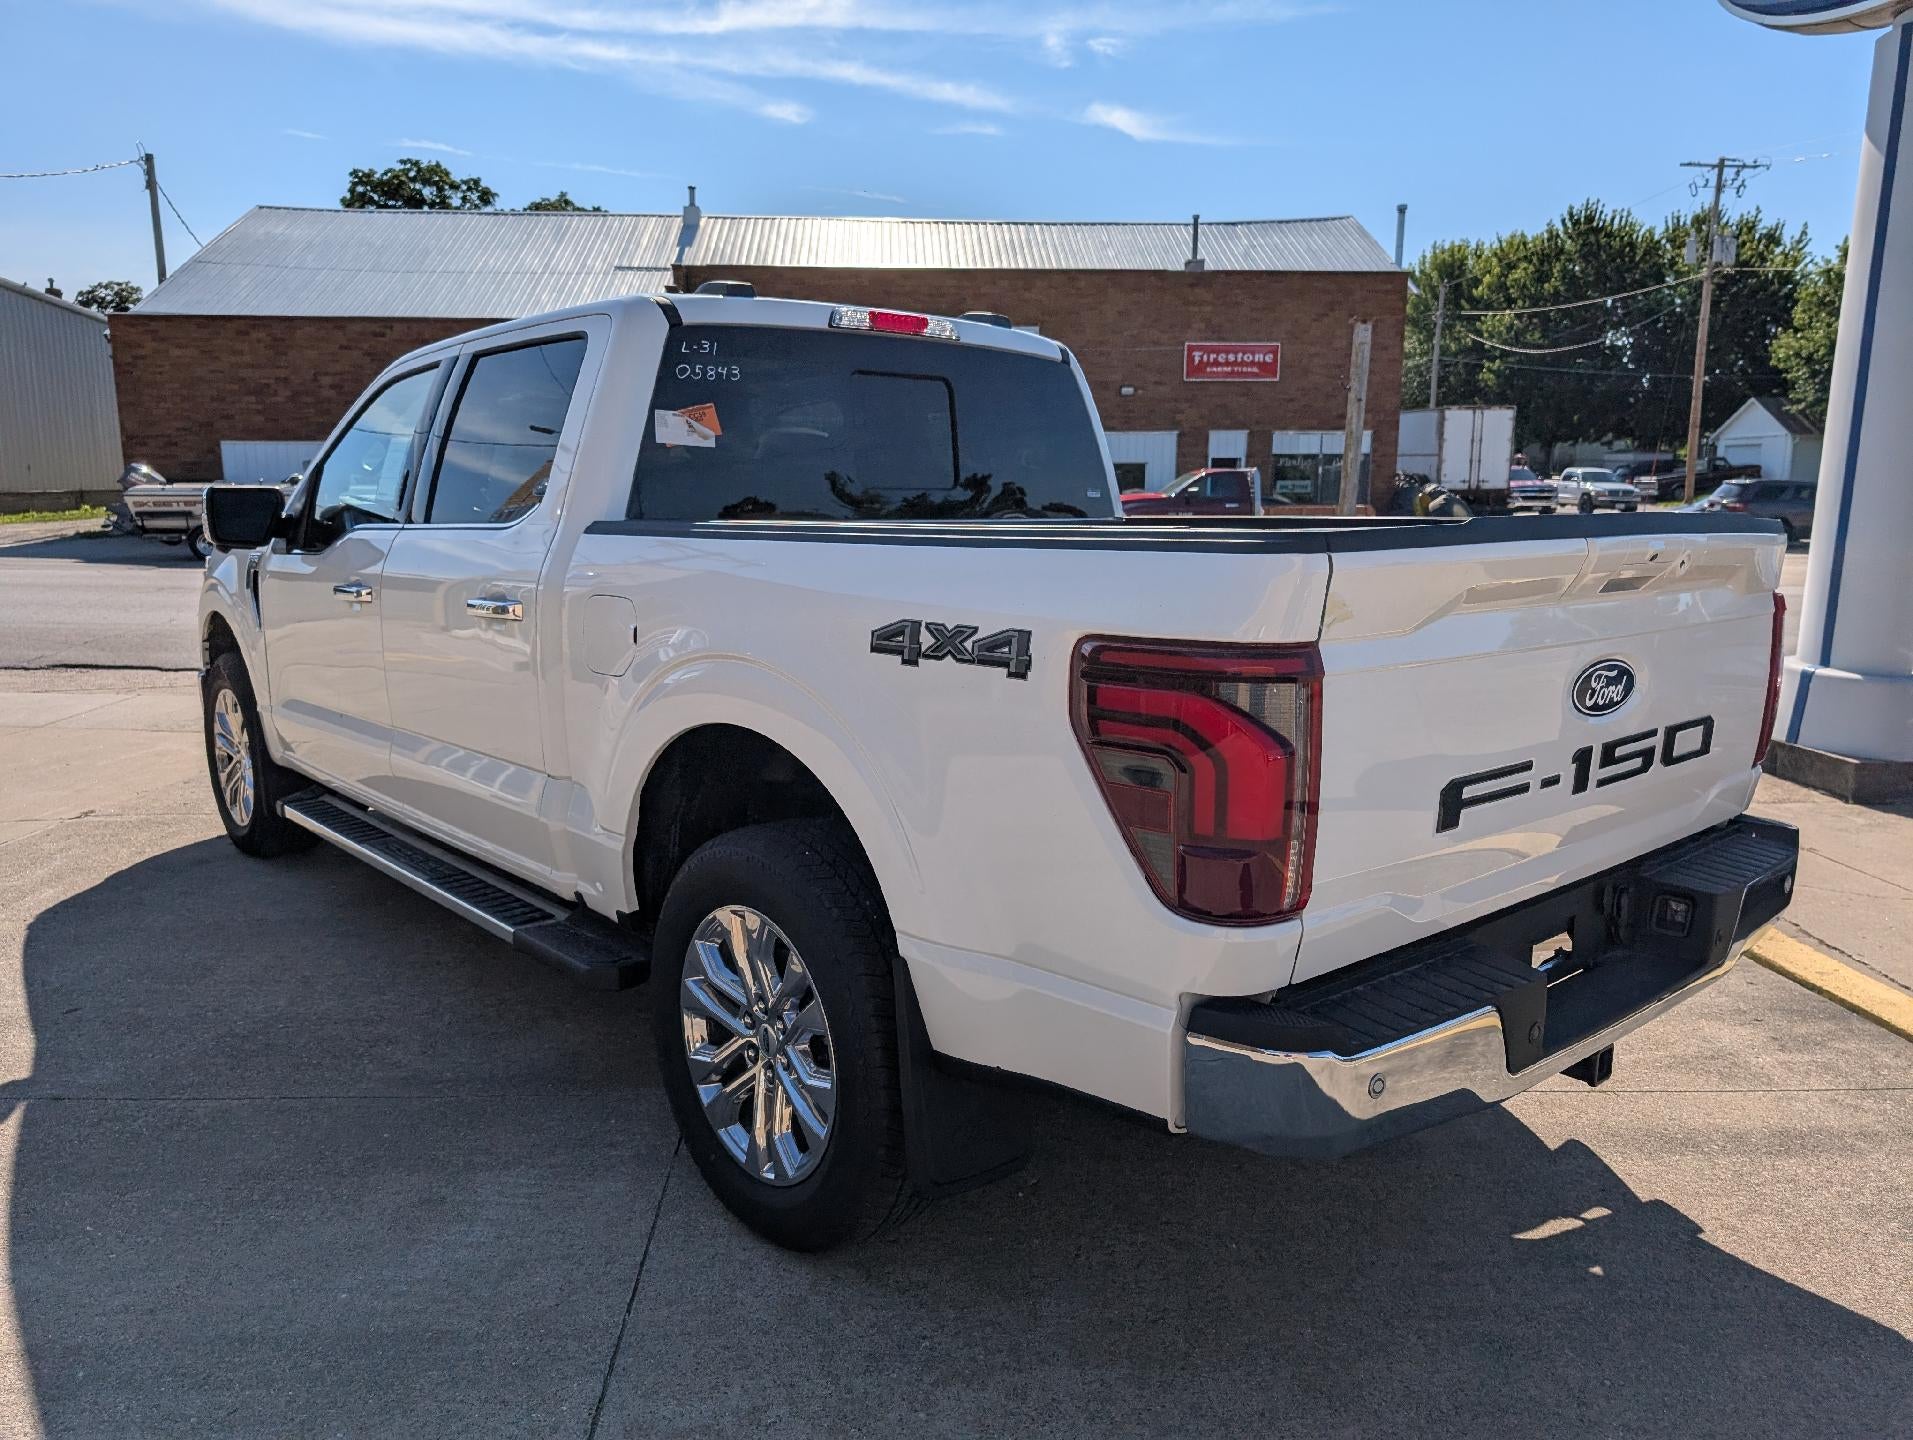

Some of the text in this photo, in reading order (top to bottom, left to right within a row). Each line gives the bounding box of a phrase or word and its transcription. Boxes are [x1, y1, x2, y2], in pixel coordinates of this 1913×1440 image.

[675, 364, 741, 381] 05843
[1192, 351, 1274, 366] Firestone
[1585, 669, 1627, 708] Ford
[1435, 714, 1715, 834] F-150
